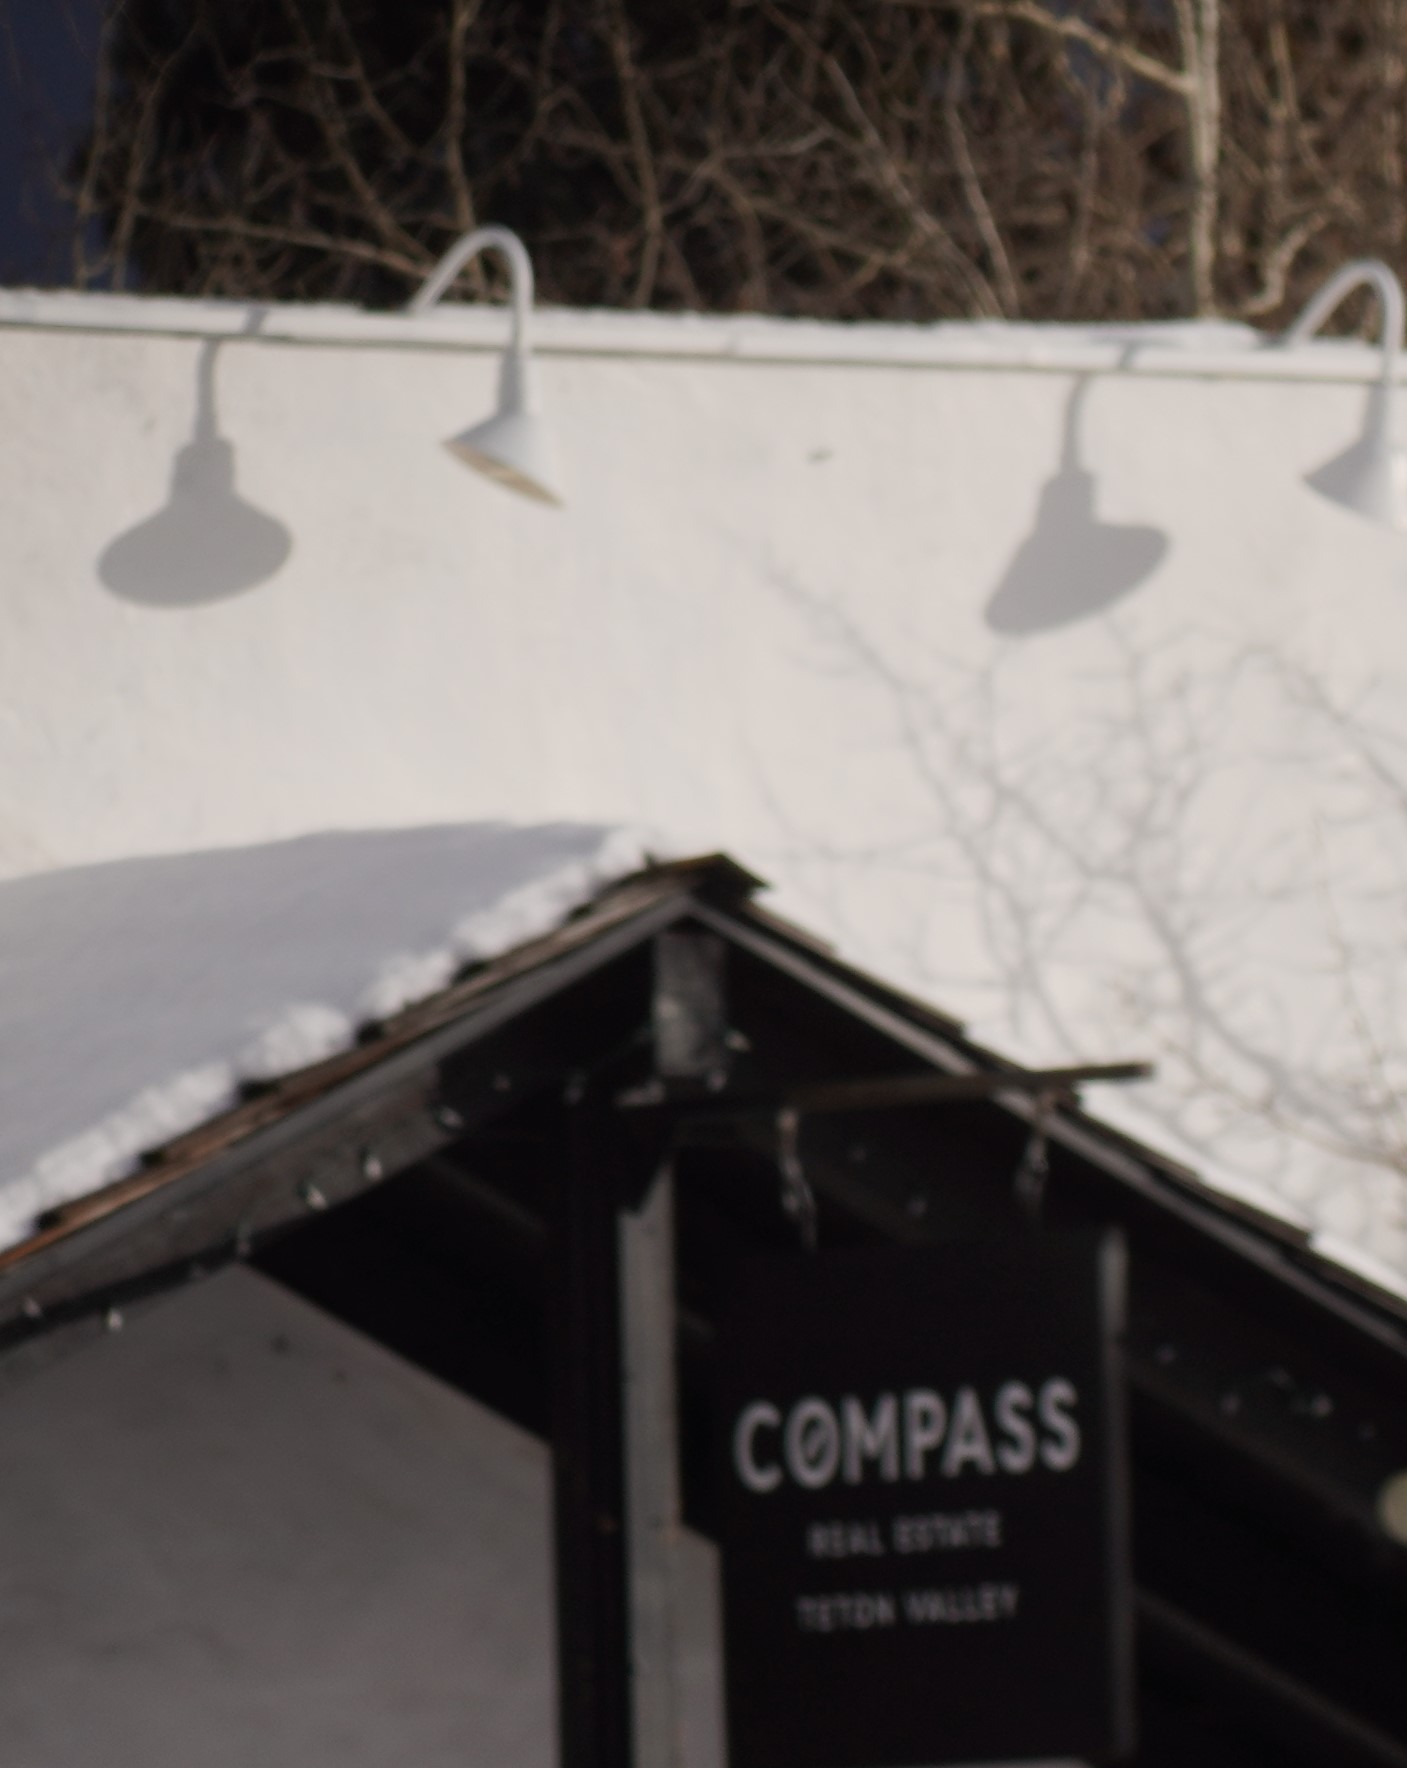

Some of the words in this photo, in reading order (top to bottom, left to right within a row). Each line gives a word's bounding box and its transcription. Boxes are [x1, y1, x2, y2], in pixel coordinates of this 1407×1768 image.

[733, 1375, 1082, 1493] COMPASS
[808, 1520, 885, 1558] REAL
[894, 1510, 1003, 1554] ESTATE
[797, 1592, 897, 1632] TETON
[906, 1585, 1018, 1625] VALLEY
